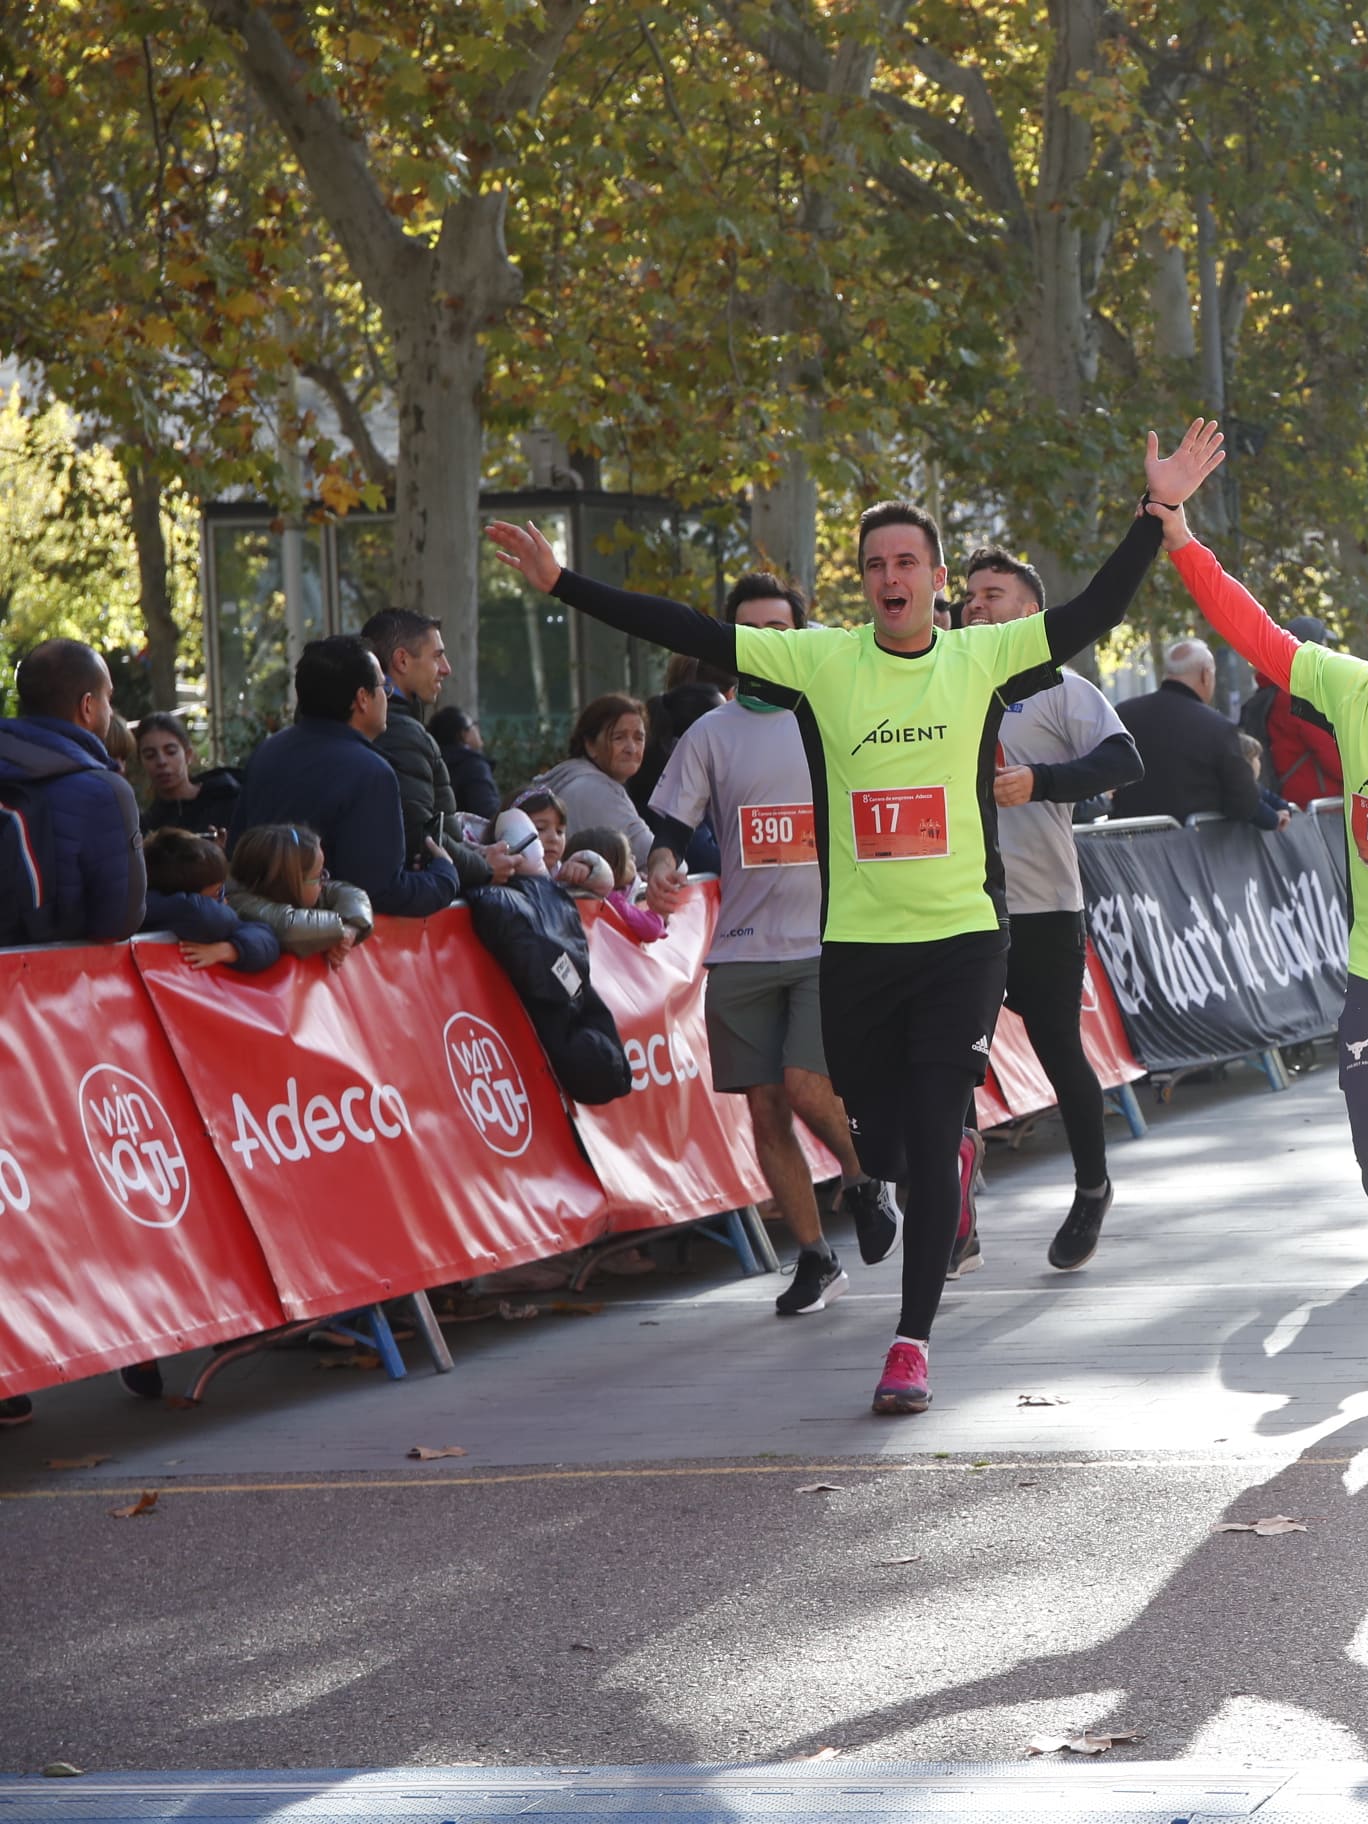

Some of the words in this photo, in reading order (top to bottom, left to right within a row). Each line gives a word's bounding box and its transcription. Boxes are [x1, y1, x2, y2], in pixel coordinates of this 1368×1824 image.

[853, 719, 948, 752] ADIENT
[751, 815, 794, 845] 390
[870, 802, 900, 834] 17
[231, 1076, 413, 1170] Adecco
